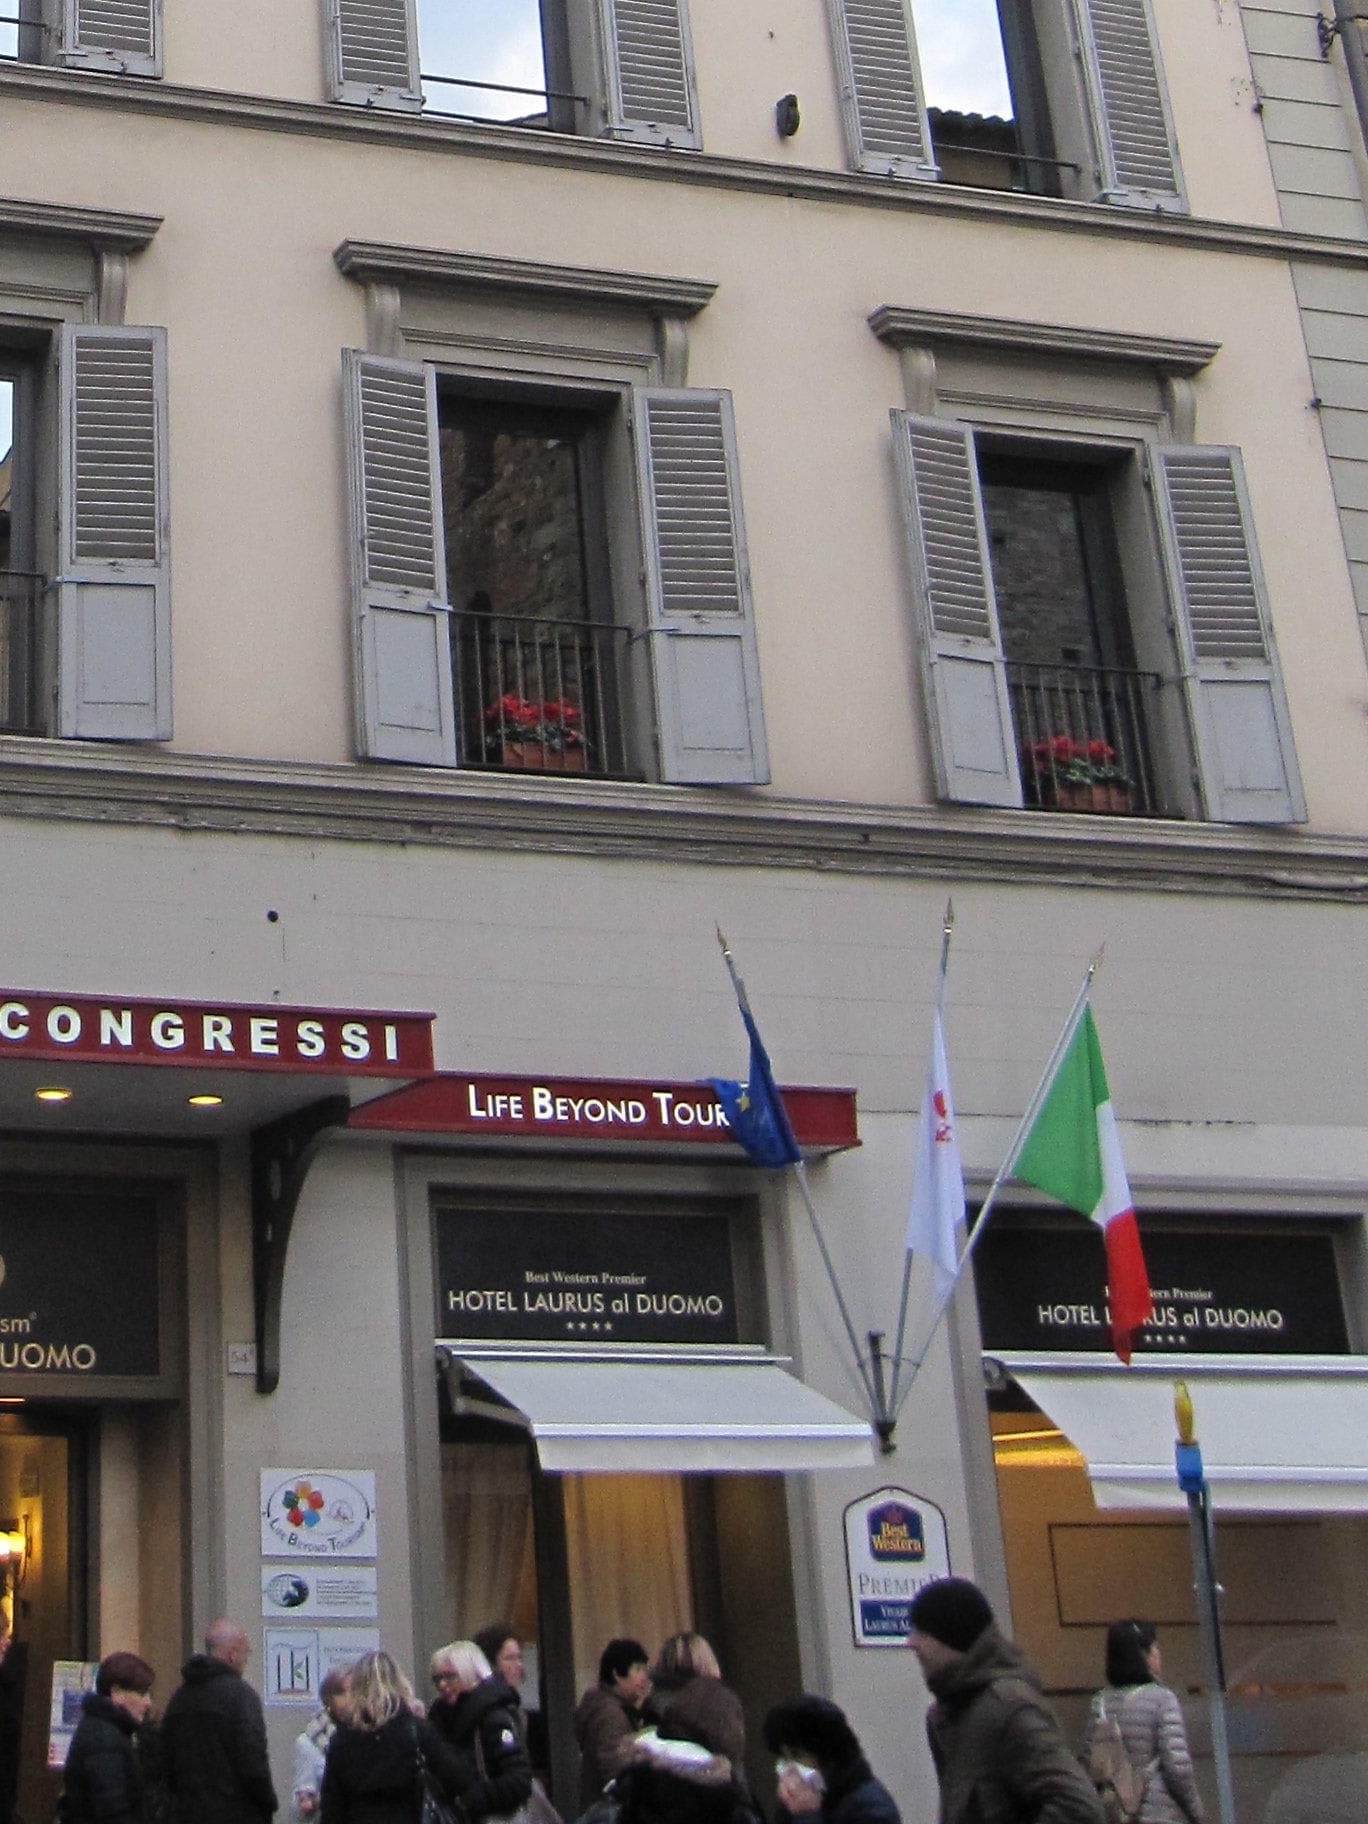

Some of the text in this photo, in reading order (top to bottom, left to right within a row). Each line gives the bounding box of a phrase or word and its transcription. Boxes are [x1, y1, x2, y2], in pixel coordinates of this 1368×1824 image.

[531, 1087, 647, 1125] BEYOND
[525, 1271, 647, 1285] Best Western Premier
[1171, 1287, 1214, 1300] Premier
[448, 1290, 724, 1316] HOTEL LAURUS al DUOMO
[1038, 1305, 1101, 1325] HOTEL
[1183, 1307, 1200, 1327] al
[1204, 1308, 1284, 1329] DUOMO
[882, 1523, 909, 1538] Best
[872, 1536, 923, 1552] Western
